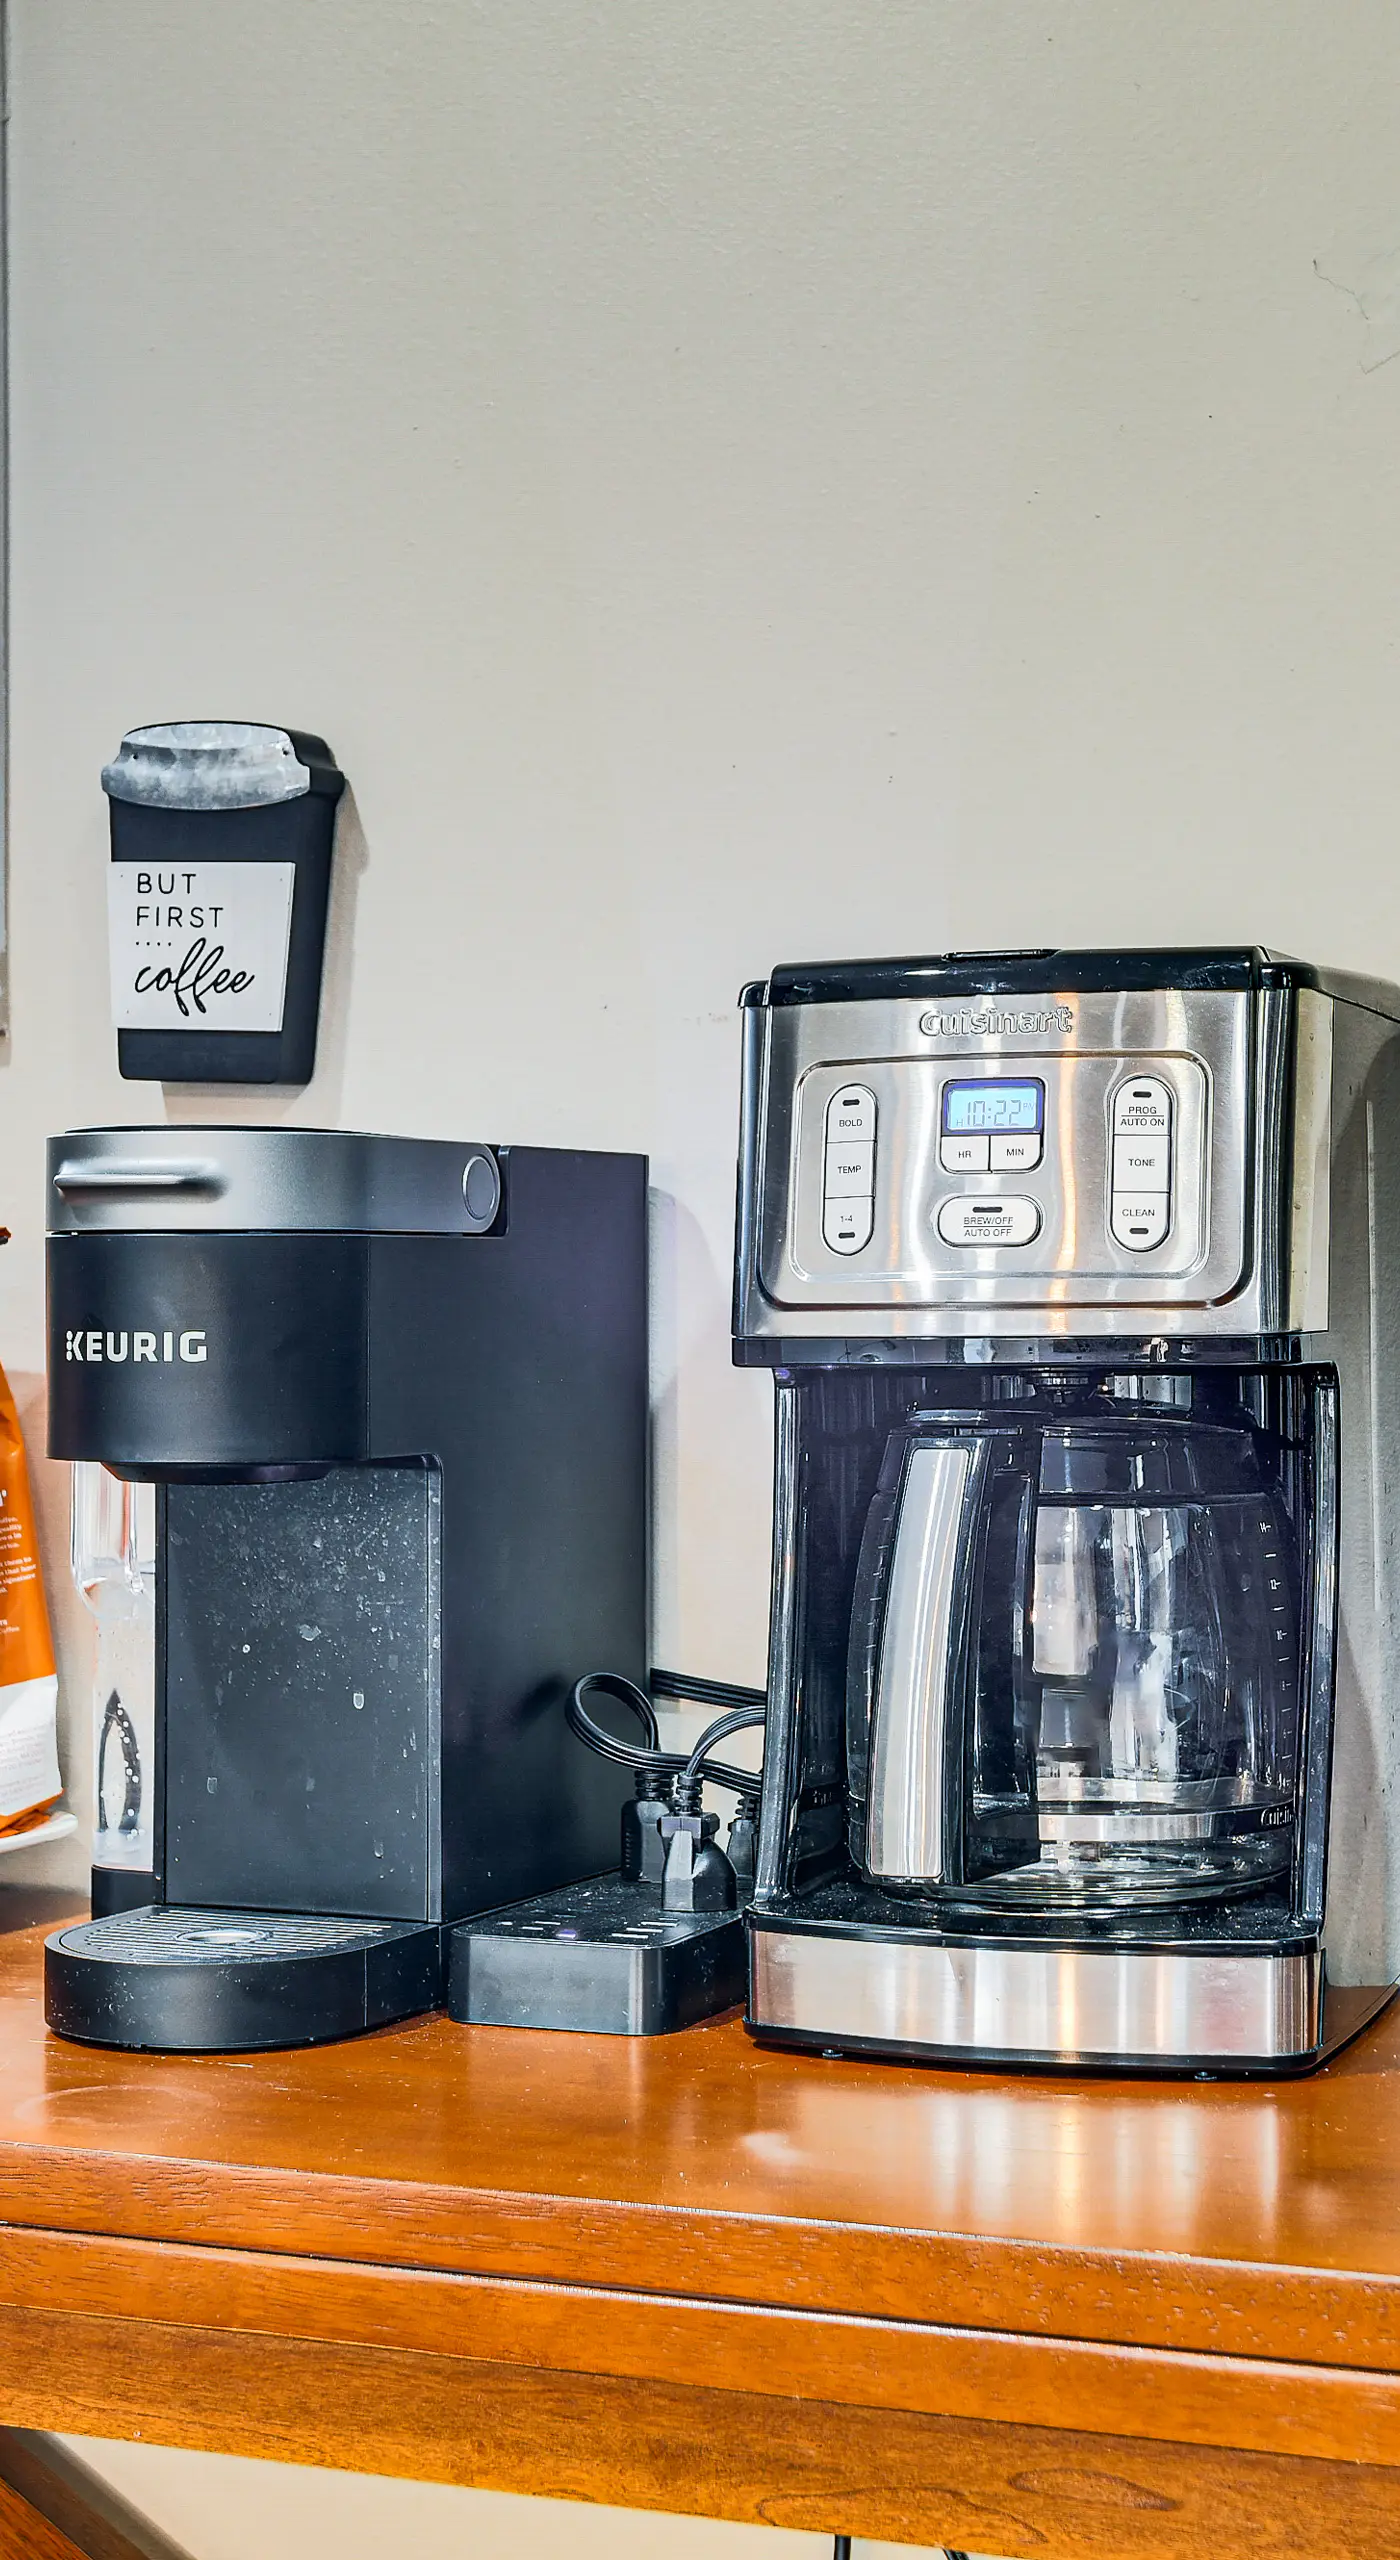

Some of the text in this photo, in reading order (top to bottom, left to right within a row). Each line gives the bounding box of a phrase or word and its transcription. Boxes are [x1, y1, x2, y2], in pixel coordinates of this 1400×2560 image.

[136, 872, 197, 895] BUT
[136, 906, 224, 929] FIRST
[134, 937, 255, 1017] coffee
[919, 1006, 1074, 1037] Cuisinart
[967, 1099, 1021, 1127] 10:22
[1128, 1105, 1157, 1115] PROG
[838, 1118, 863, 1128] BOLD
[1120, 1117, 1165, 1127] AUTO ON
[958, 1150, 972, 1159] HR
[1006, 1148, 1025, 1157] MIN
[1128, 1158, 1156, 1167] TONE
[837, 1164, 862, 1174] TEMP
[1121, 1208, 1156, 1217] CLEAN
[963, 1216, 1014, 1225] BREW/OFF
[964, 1228, 1013, 1237] AUTO OFF
[65, 1330, 208, 1363] KEURIG
